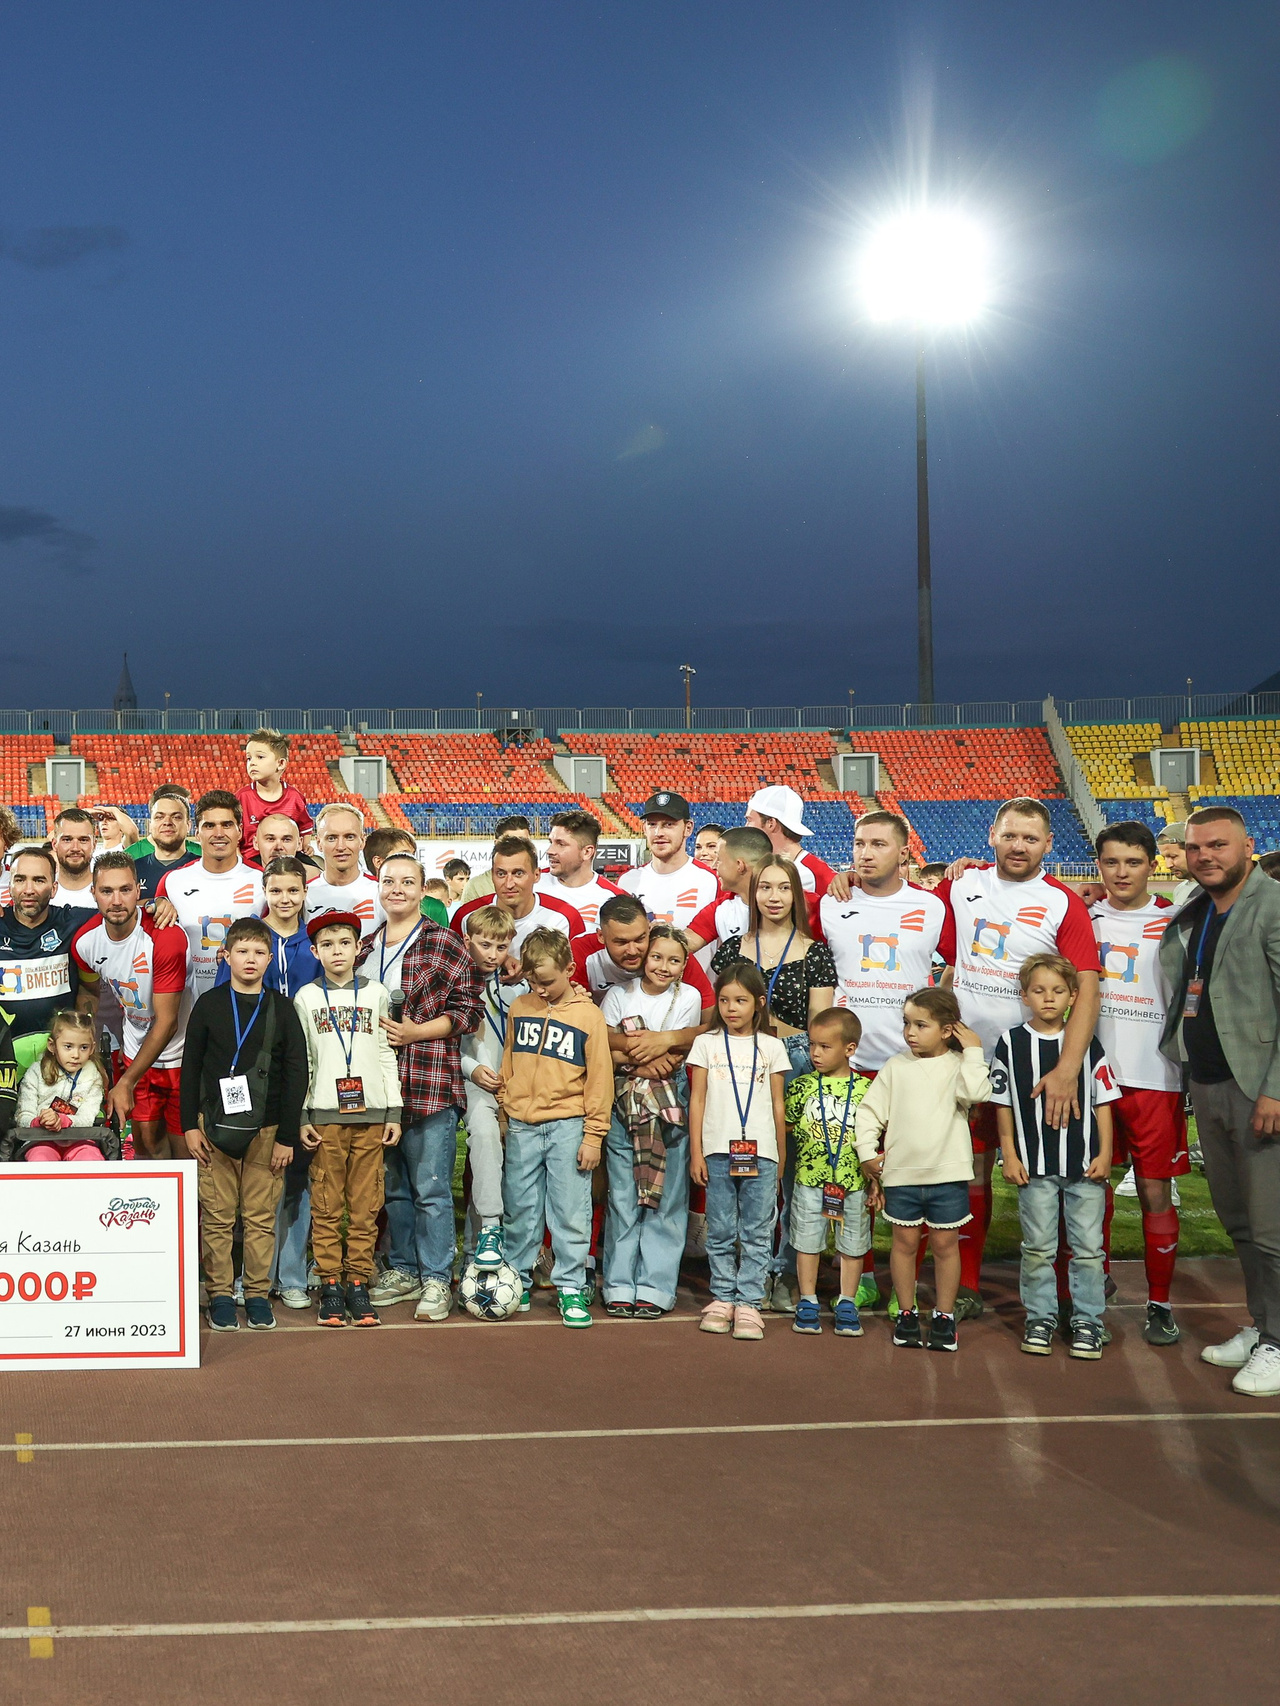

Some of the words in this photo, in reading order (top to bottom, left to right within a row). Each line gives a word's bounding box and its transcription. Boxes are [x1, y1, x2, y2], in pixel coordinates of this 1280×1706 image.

[26, 967, 69, 991] ВМЕСТЕ
[981, 966, 1002, 977] боремся
[876, 980, 898, 991] боремся
[1109, 990, 1134, 1003] боремся
[1134, 996, 1154, 1006] вместе
[991, 1068, 1008, 1094] 3
[108, 1197, 160, 1213] Добрая
[99, 1208, 156, 1231] Казань
[17, 1230, 82, 1254] Казань
[64, 1325, 81, 1338] 27
[85, 1326, 126, 1338] июня
[130, 1323, 167, 1337] 2023
